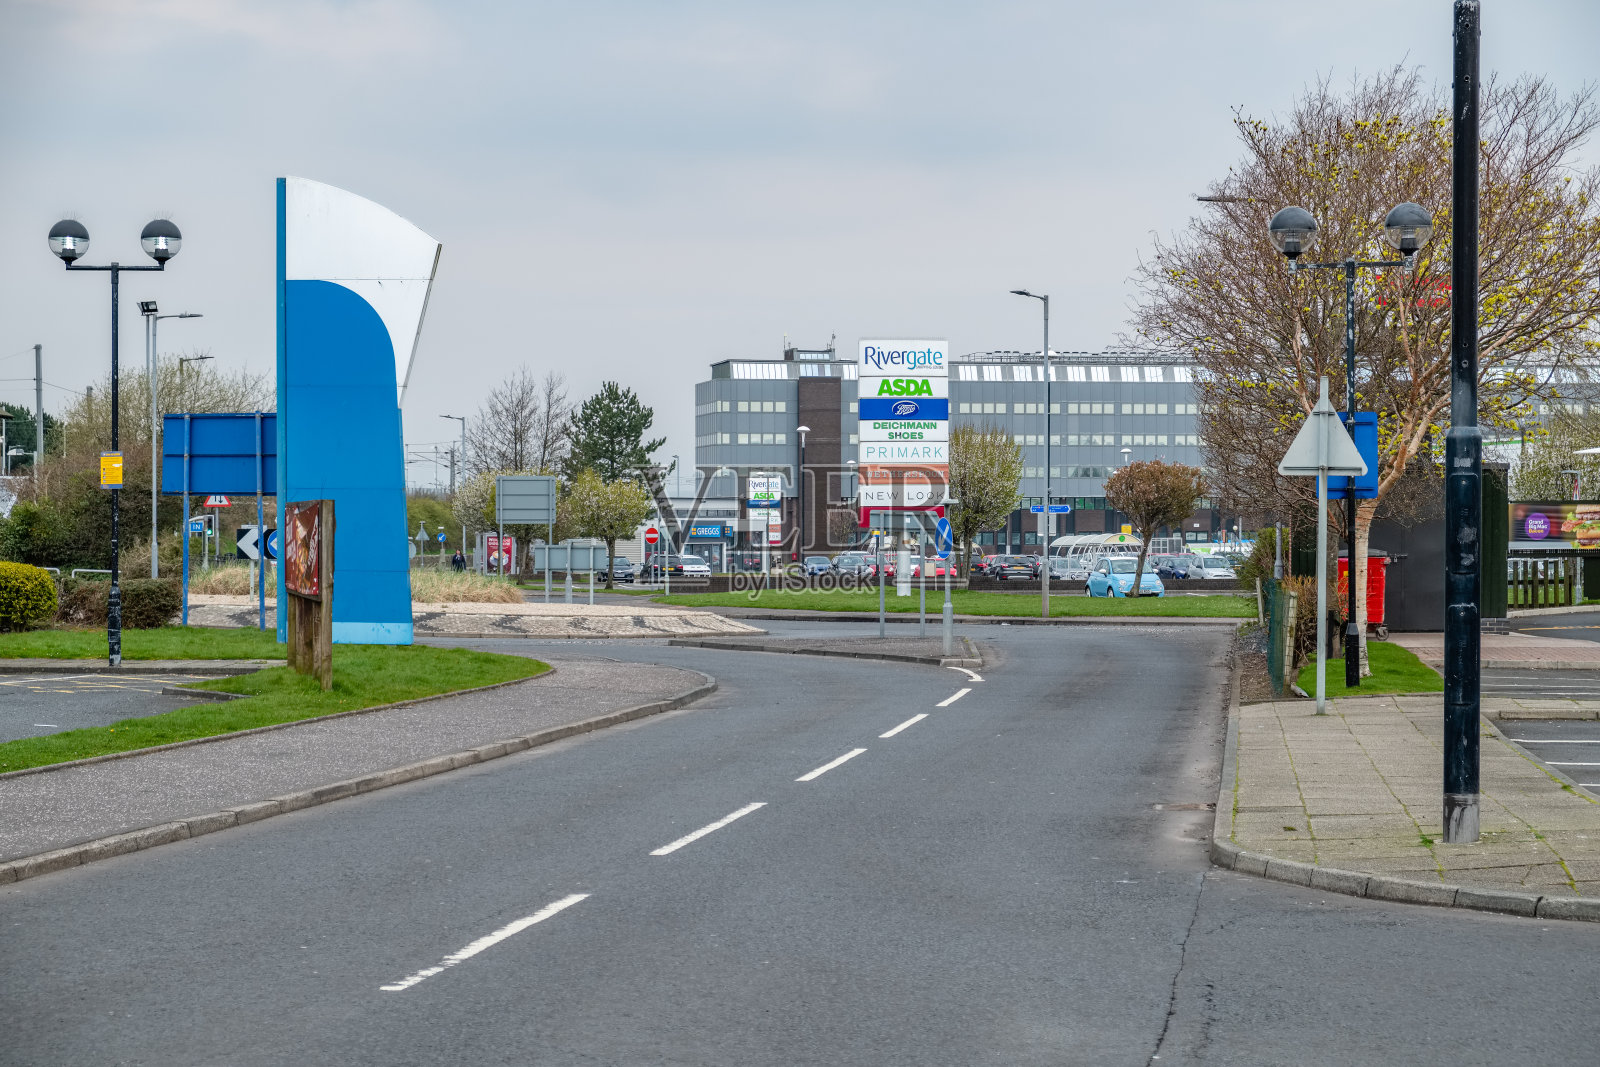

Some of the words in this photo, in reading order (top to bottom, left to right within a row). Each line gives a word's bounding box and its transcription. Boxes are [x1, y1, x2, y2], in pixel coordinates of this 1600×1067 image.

[864, 346, 943, 370] Rivergate
[877, 379, 933, 396] ASDA
[866, 447, 943, 458] PRIMARK
[865, 492, 899, 500] NEW
[907, 492, 945, 500] LOOK
[697, 527, 720, 535] GREGGS
